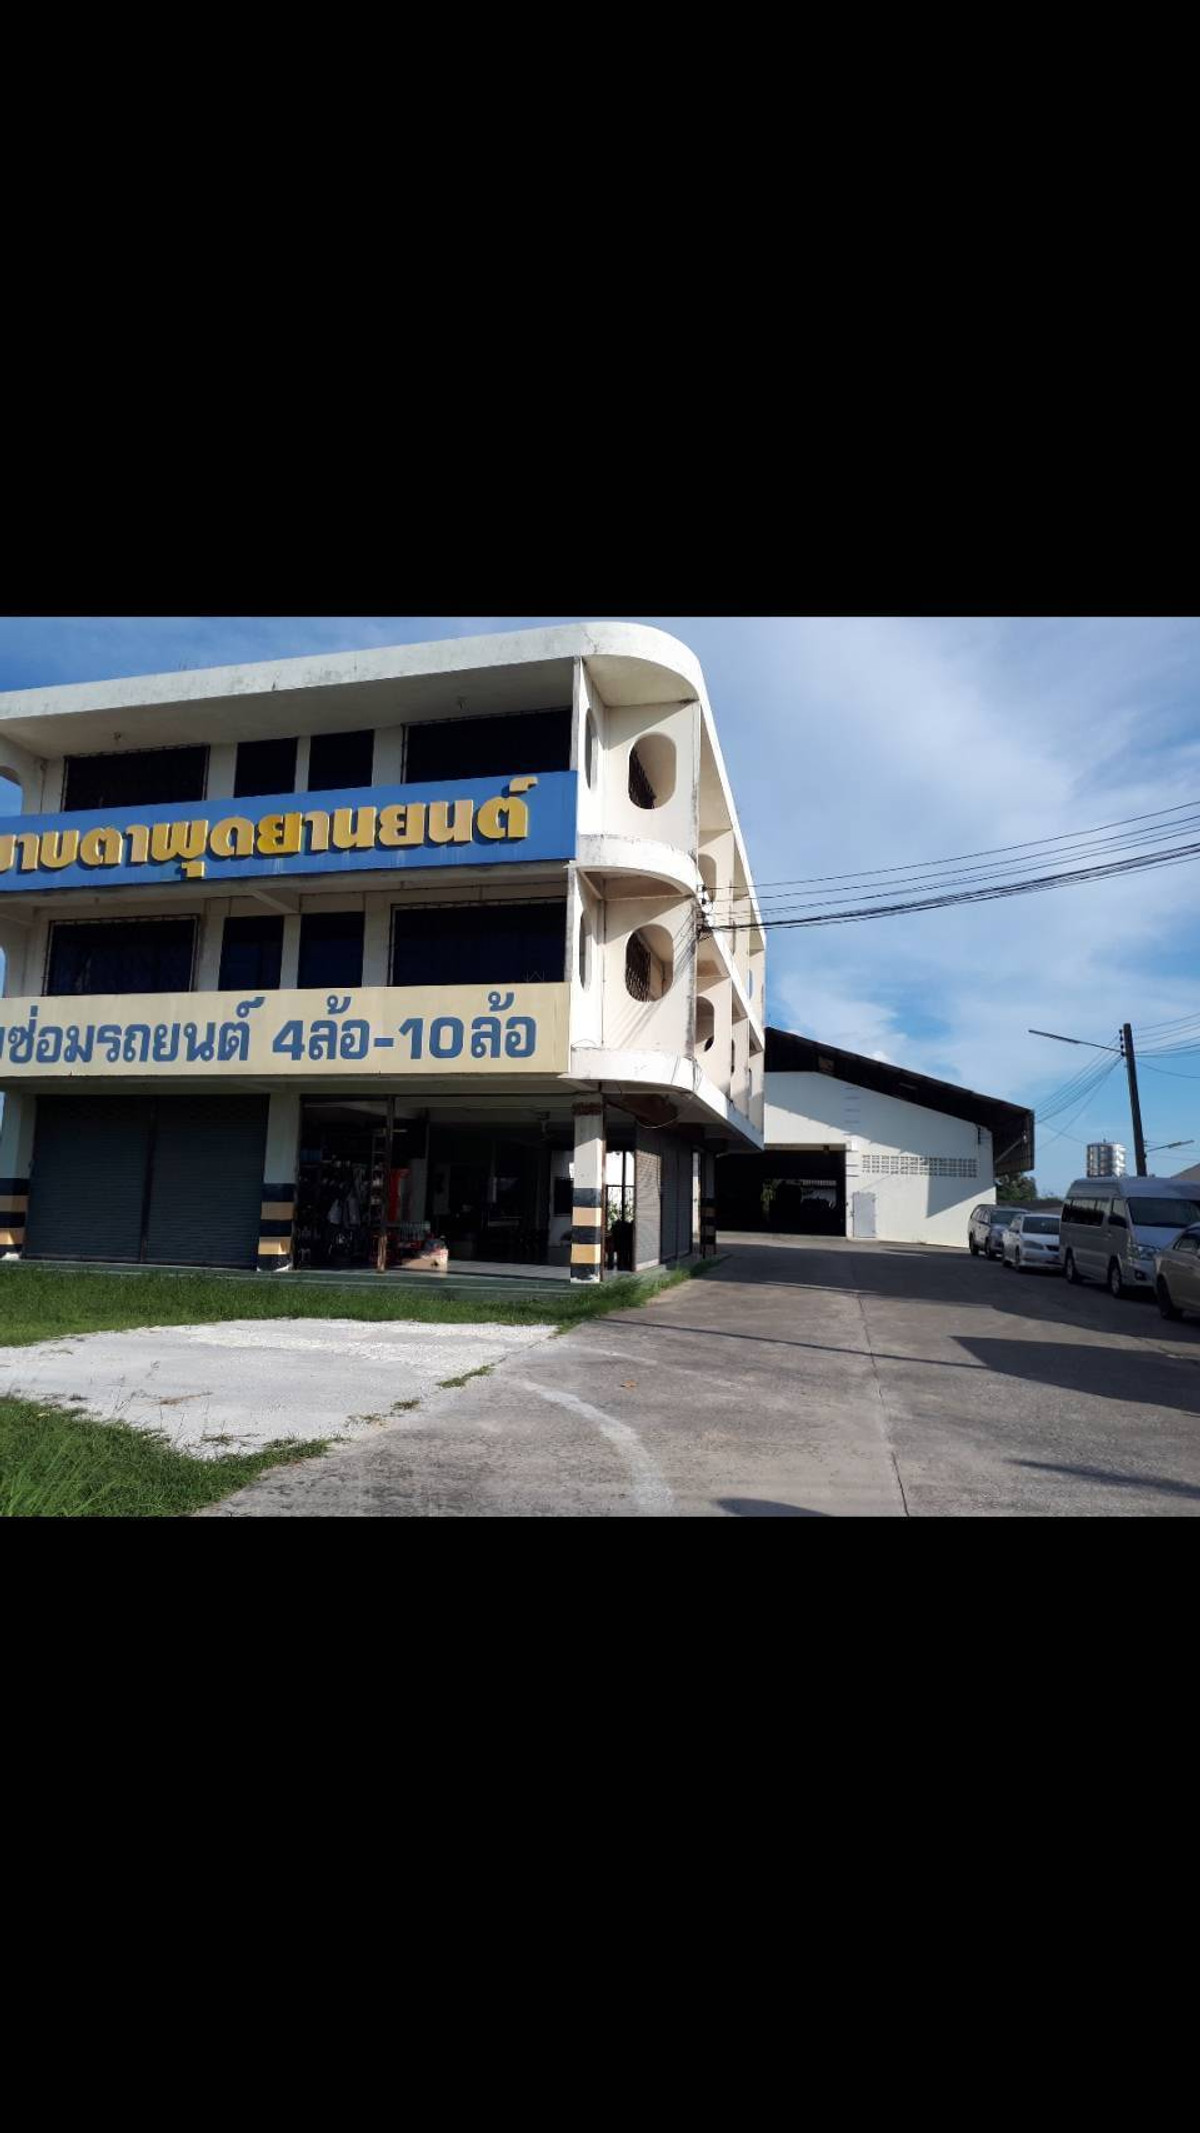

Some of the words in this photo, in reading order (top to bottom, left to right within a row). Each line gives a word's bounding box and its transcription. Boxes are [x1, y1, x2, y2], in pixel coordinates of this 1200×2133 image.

[0, 997, 265, 1063] ซ่อมรถยนต์
[272, 990, 537, 1061] 4ล้อ-10ล้อ
